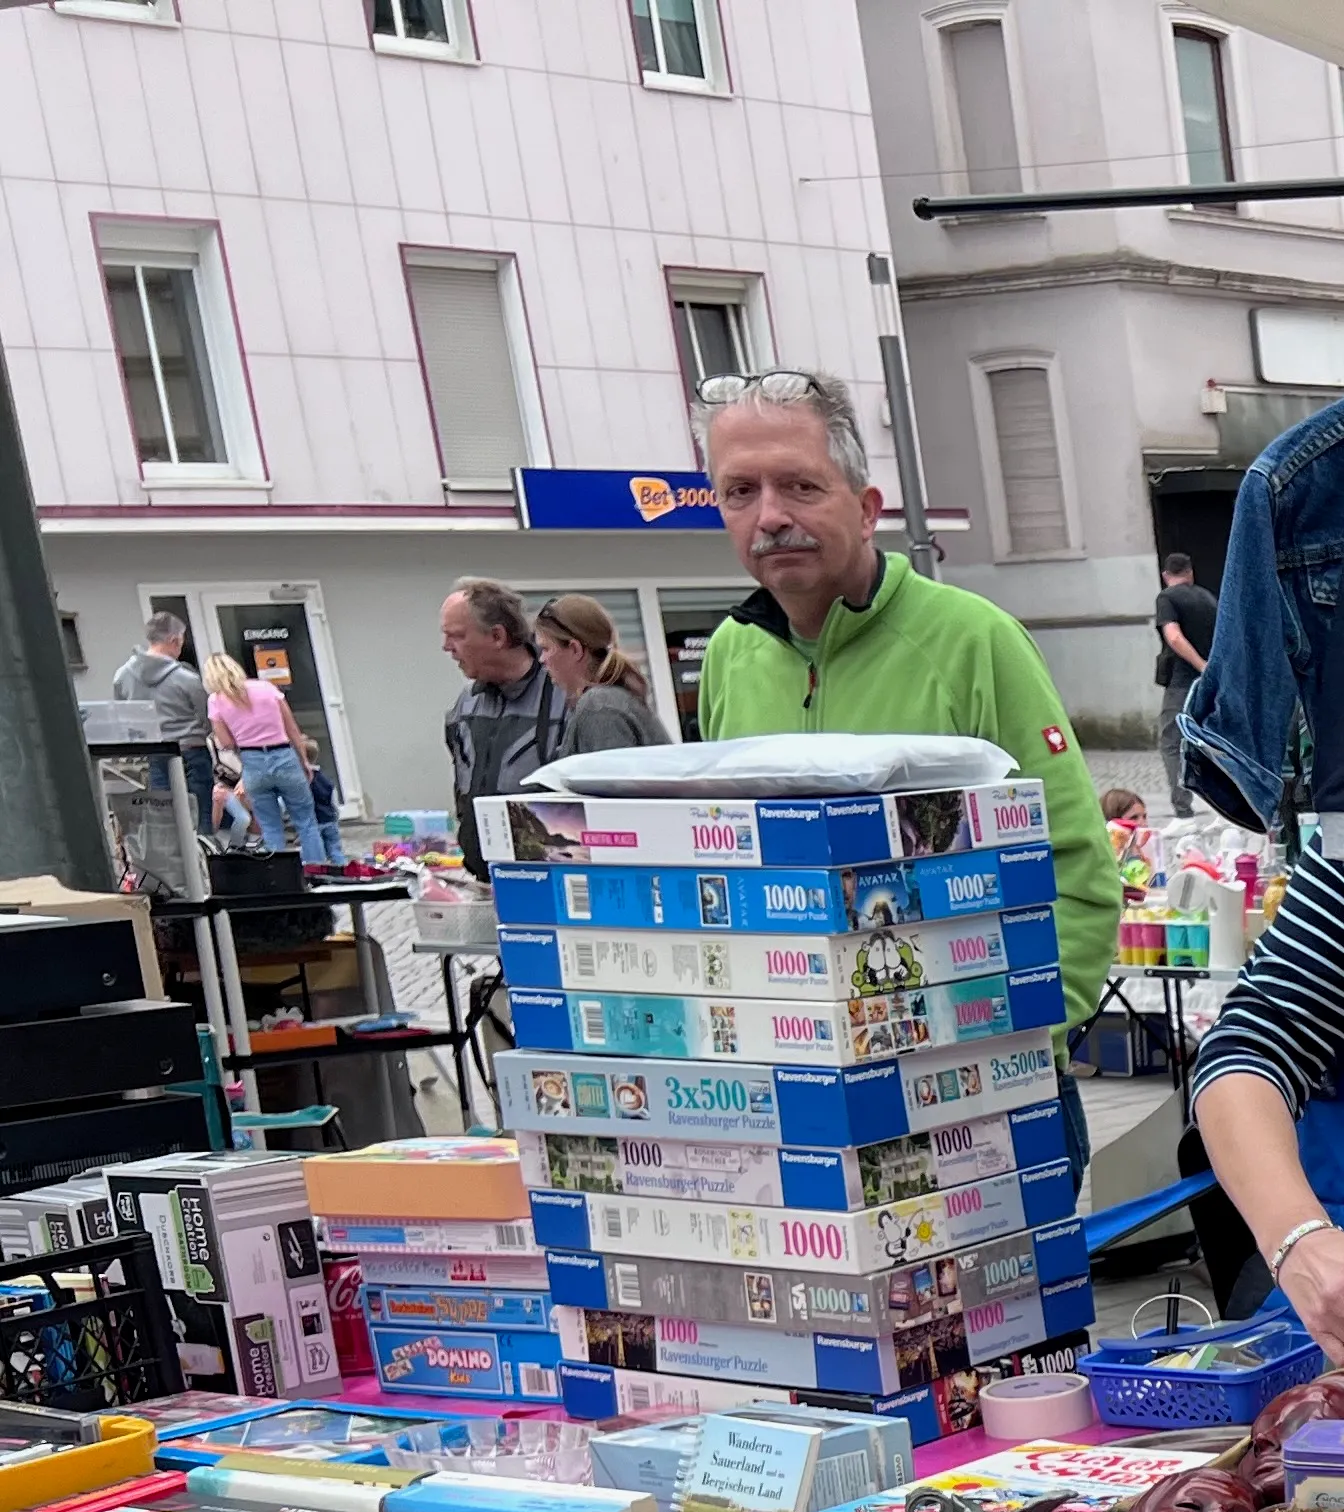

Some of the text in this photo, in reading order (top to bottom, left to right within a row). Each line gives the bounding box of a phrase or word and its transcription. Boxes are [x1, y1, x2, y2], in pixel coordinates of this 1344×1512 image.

[640, 485, 669, 507] Bet
[243, 628, 290, 641] EINGANG
[759, 806, 820, 822] Ravensburger
[826, 802, 881, 818] Ravensburger
[993, 804, 1029, 831] 1000
[691, 824, 735, 851] 1000
[999, 848, 1050, 864] Ravensburger
[494, 867, 549, 883] Ravensburger
[858, 872, 900, 889] AVATAR
[919, 863, 955, 877] AVATAR
[763, 884, 807, 911] 1000
[945, 873, 983, 902] 1000
[1002, 909, 1051, 927] Ravensburger
[501, 930, 554, 946] Ravensburger
[949, 935, 987, 964] 1000
[765, 949, 808, 976] 1000
[1009, 969, 1058, 987] Ravensburger
[511, 993, 564, 1009] Ravensburger
[772, 1015, 813, 1042] 1000
[776, 1070, 838, 1087] Ravensburger
[844, 1064, 896, 1084] Ravensburger
[990, 1050, 1036, 1083] 3x500
[665, 1075, 747, 1112] 3x500
[668, 1110, 777, 1131] Ravensburger Puzzle
[1010, 1105, 1059, 1125] Ravensburger
[932, 1125, 973, 1157] 1000
[621, 1139, 663, 1168] 1000
[781, 1150, 840, 1168] Ravensburger
[625, 1171, 736, 1194] Ravensburger Puzzle
[1021, 1165, 1070, 1185] Ravensburger
[531, 1192, 583, 1209] Ravensburger
[945, 1187, 983, 1219] 1000
[180, 1197, 199, 1261] Creation
[188, 1197, 210, 1261] Home
[779, 1219, 842, 1261] 1000
[1034, 1221, 1082, 1244] Ravensburger
[547, 1252, 600, 1269] Ravensburger
[983, 1256, 1020, 1288] 1000
[1041, 1274, 1090, 1298] Ravensburger
[808, 1286, 850, 1313] 1000
[968, 1300, 1006, 1335] 1000
[659, 1319, 698, 1345] 1000
[816, 1335, 874, 1352] Ravensburger
[261, 1344, 275, 1396] Creation
[426, 1348, 492, 1371] DOMINO
[659, 1346, 769, 1374] Ravensburger Puzzle
[1038, 1346, 1076, 1376] 1000
[249, 1347, 267, 1397] Home
[561, 1365, 613, 1383] Ravensburger
[875, 1387, 930, 1414] Ravensburger
[727, 1431, 773, 1455] Wandern
[711, 1450, 766, 1476] Sauerland
[701, 1471, 783, 1501] Bergischen Land
